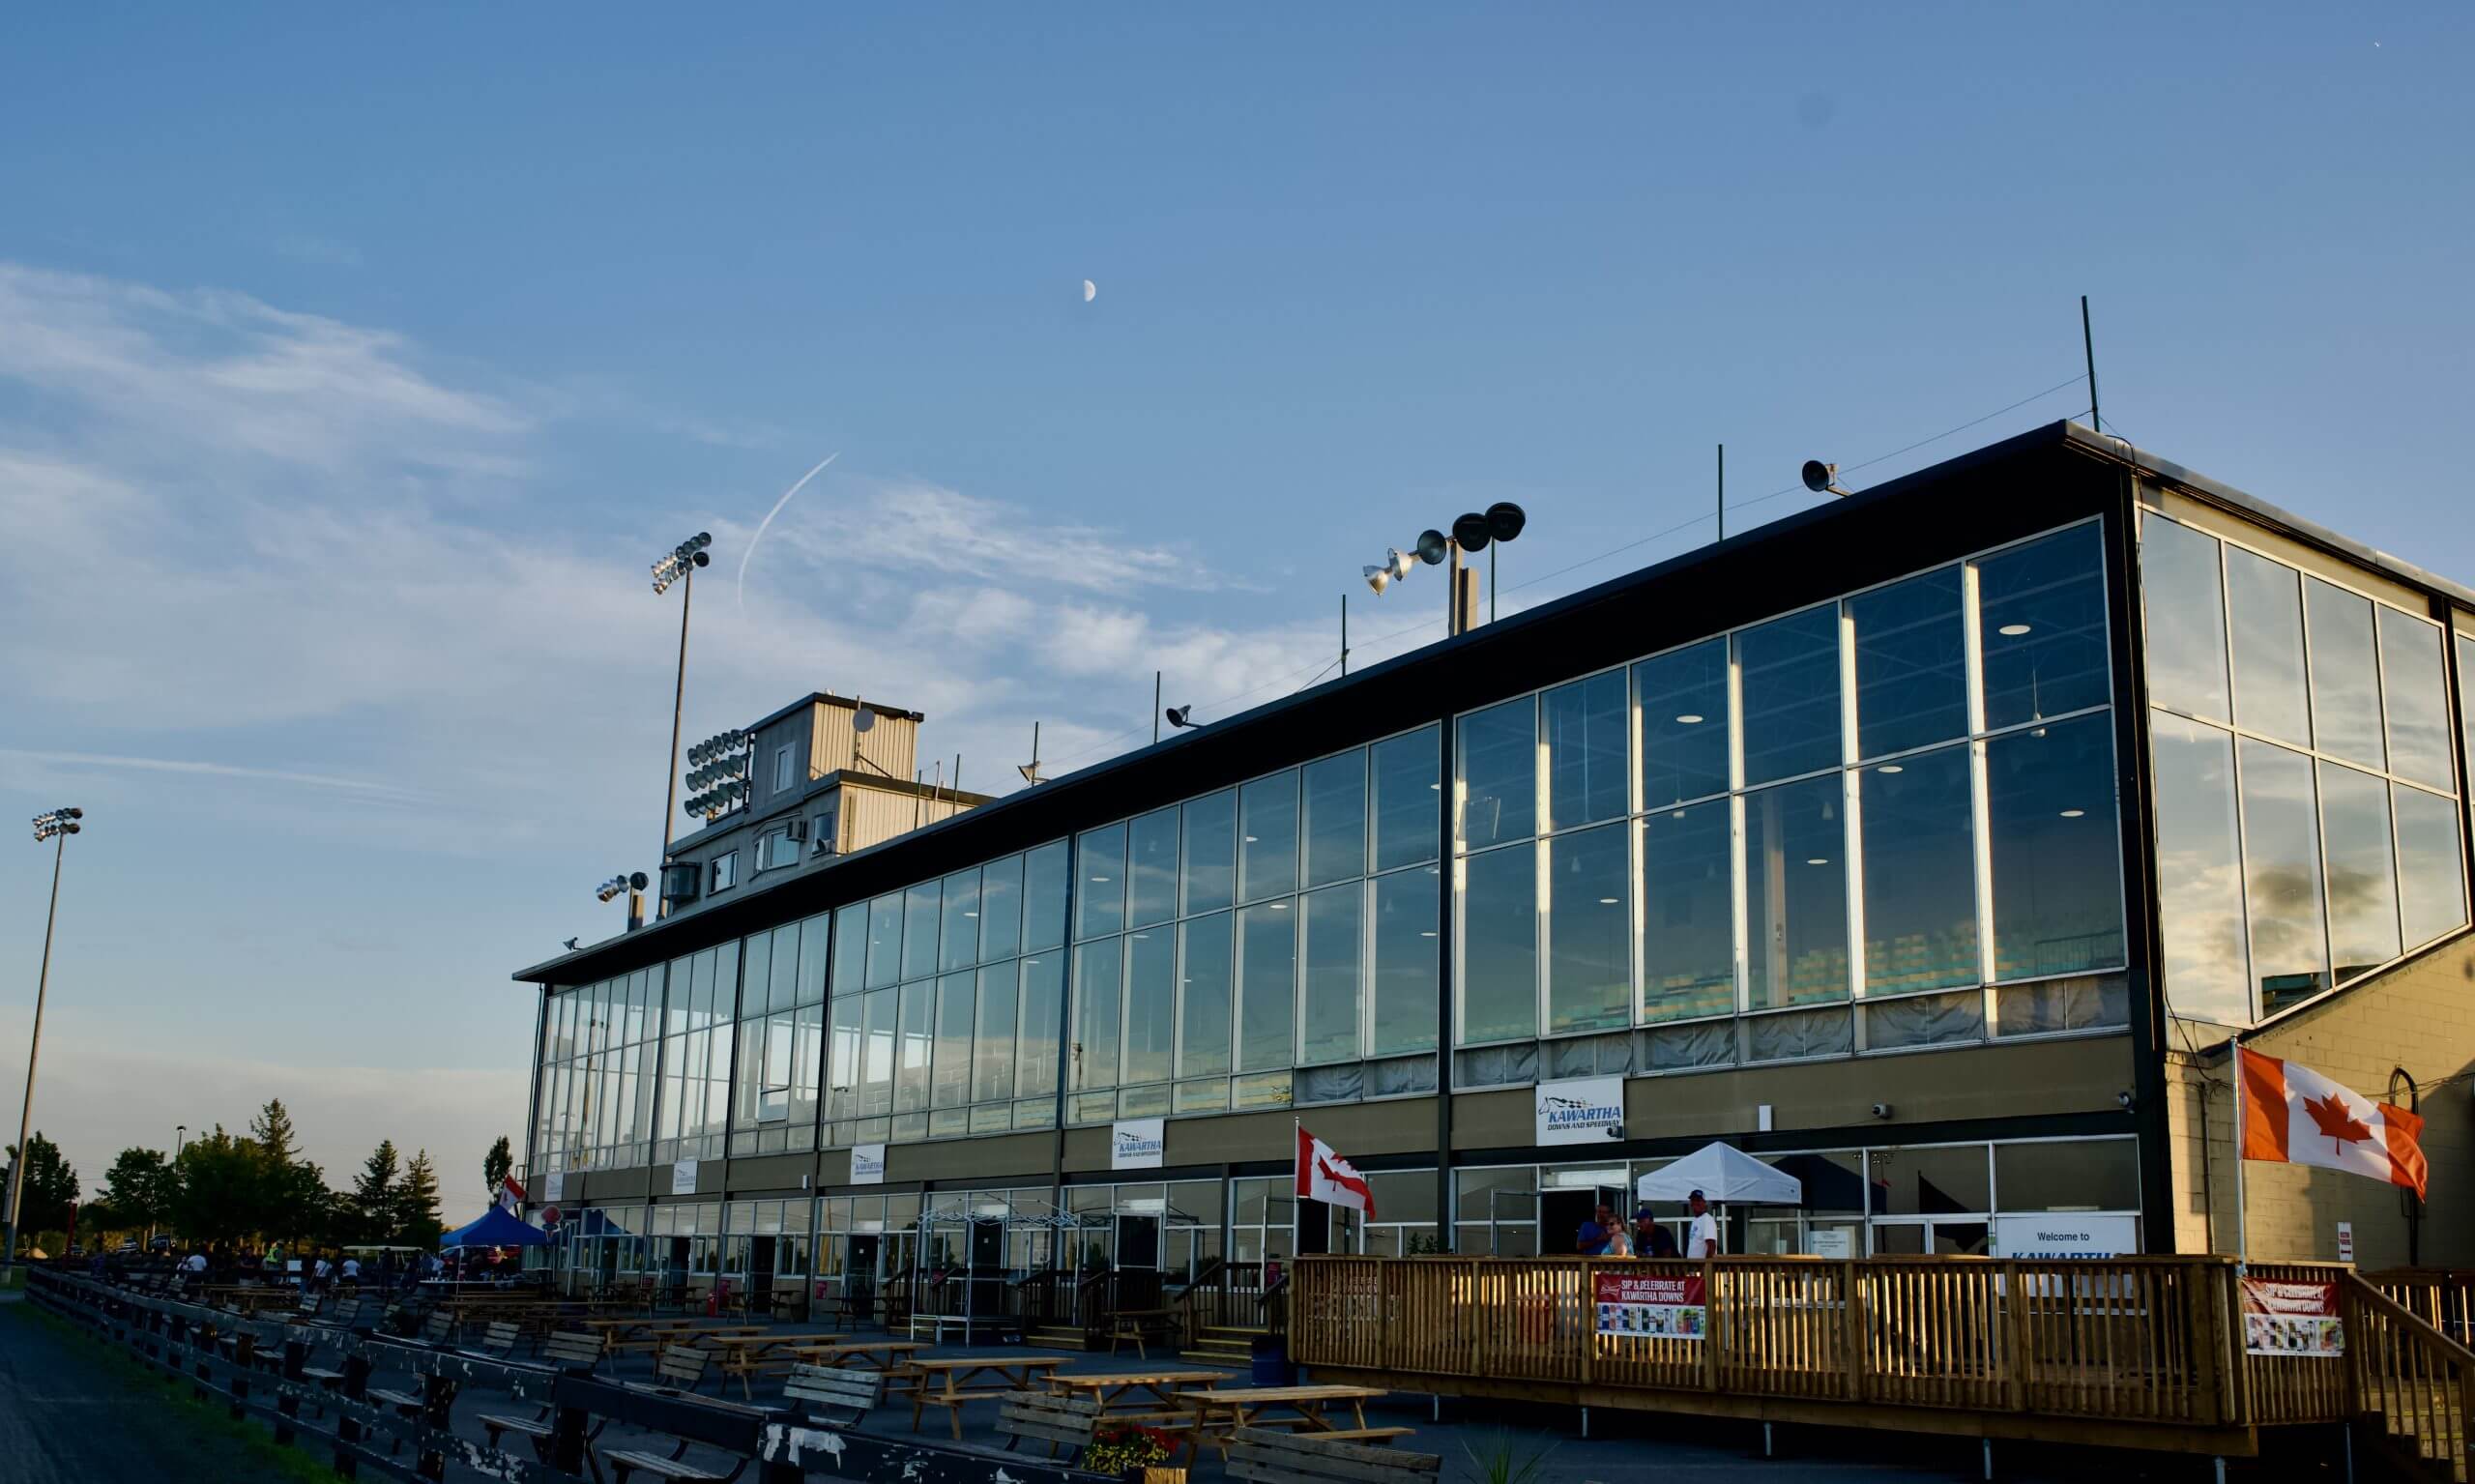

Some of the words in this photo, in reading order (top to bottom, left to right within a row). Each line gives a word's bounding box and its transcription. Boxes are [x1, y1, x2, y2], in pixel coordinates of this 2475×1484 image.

[1549, 1106, 1621, 1123] KAWARTHA
[1547, 1121, 1571, 1131] DOWNS
[2037, 1232, 2079, 1241] Welcome
[2080, 1232, 2090, 1241] to
[1621, 1280, 1633, 1291] SIP
[1639, 1280, 1676, 1292] CELEBRATE
[1676, 1281, 1685, 1292] AT
[1621, 1292, 1657, 1302] KAWARTHA
[1658, 1293, 1684, 1302] DOWNS
